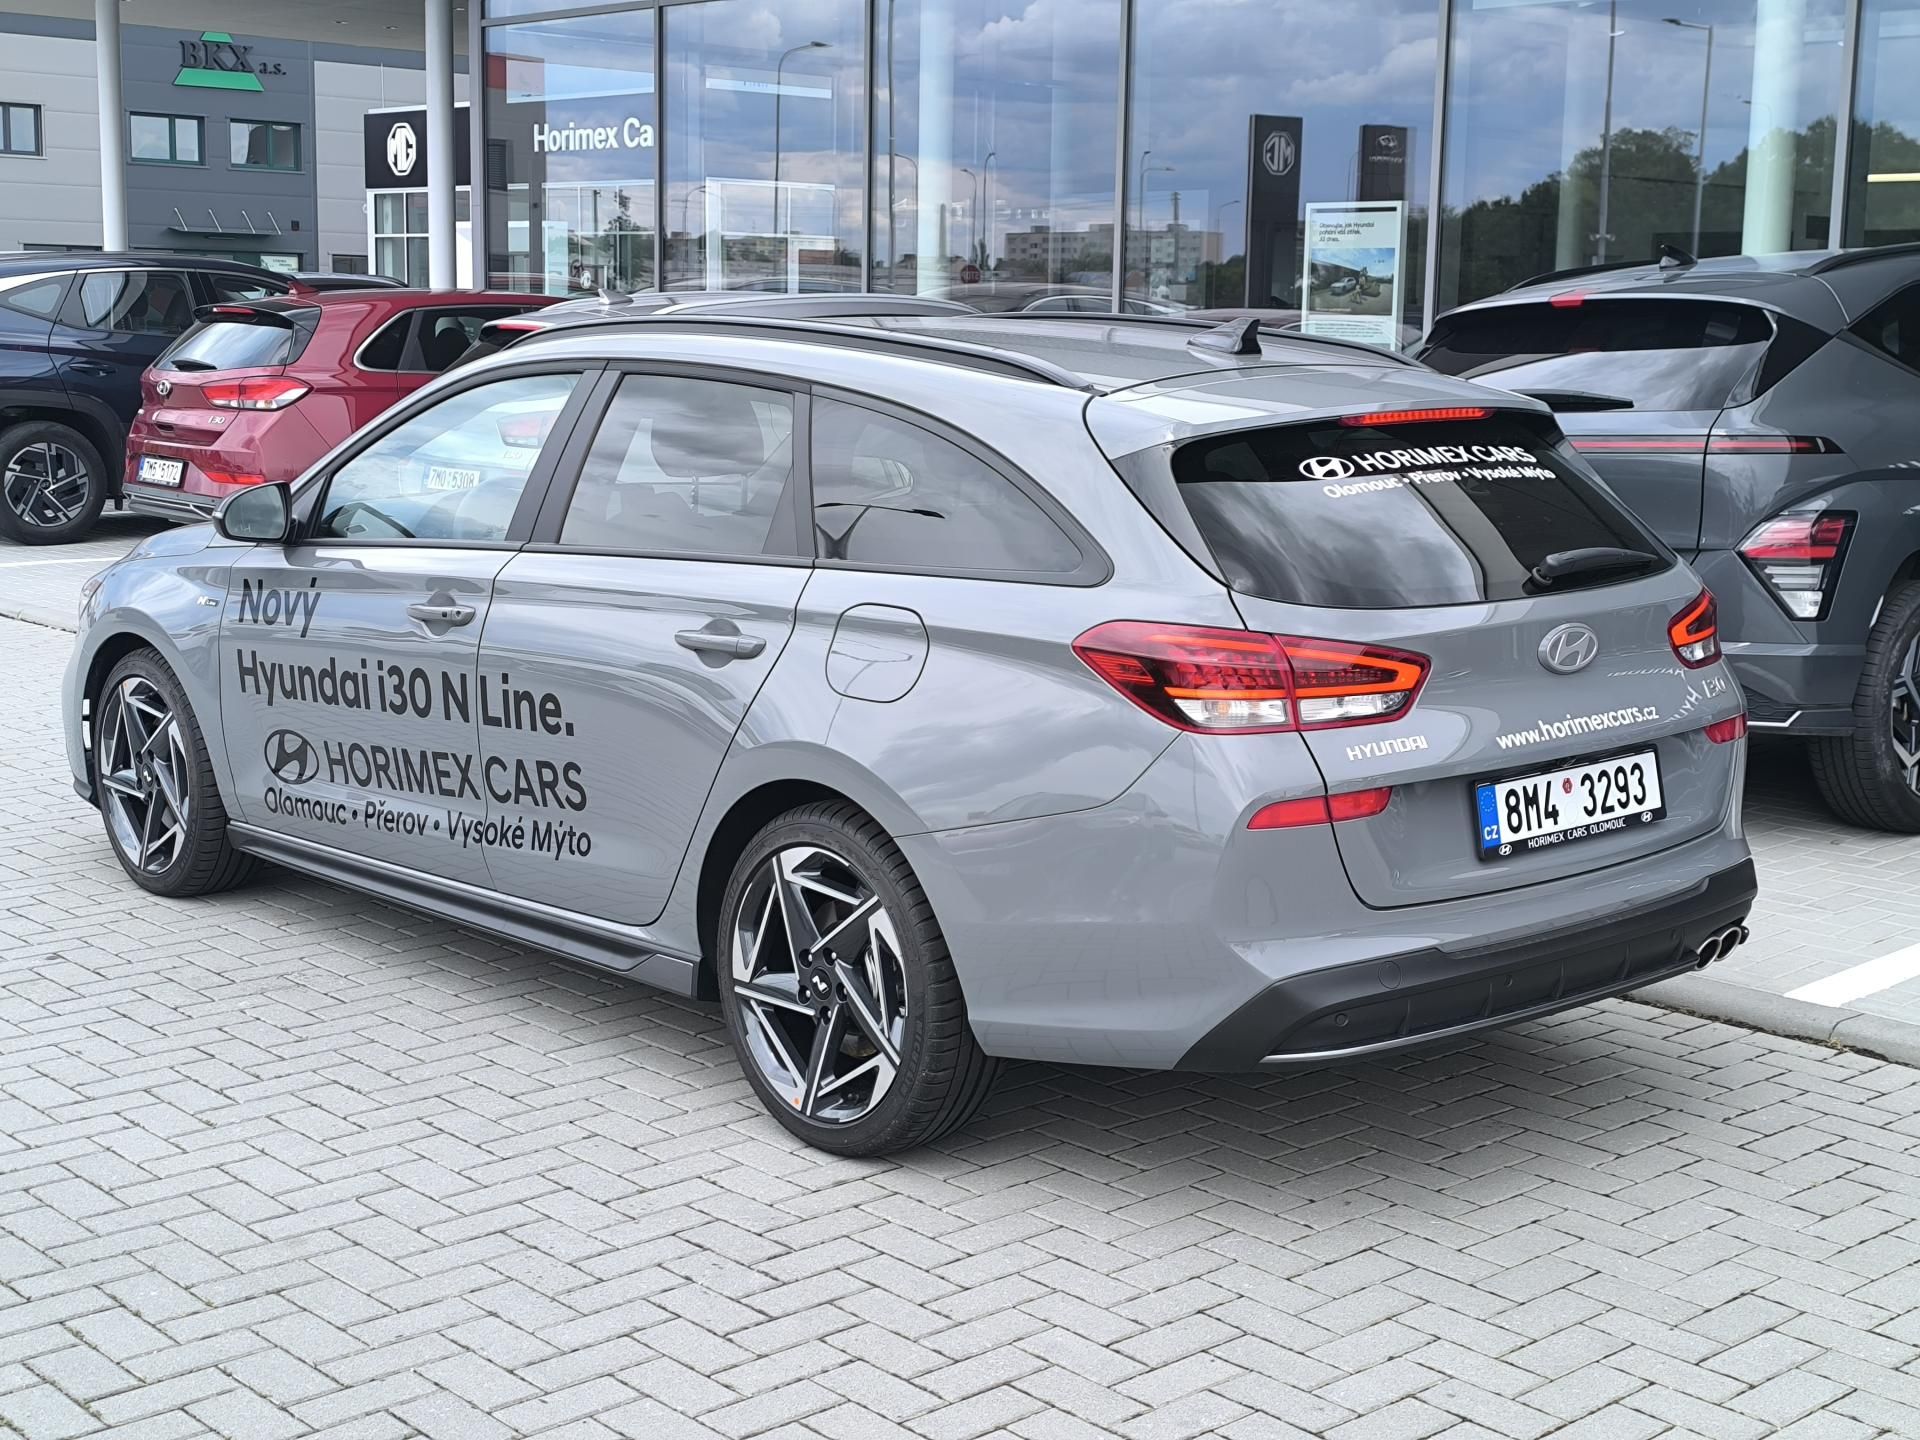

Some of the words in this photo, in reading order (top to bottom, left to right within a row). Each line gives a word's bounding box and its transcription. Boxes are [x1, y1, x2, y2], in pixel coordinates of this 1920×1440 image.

[179, 40, 255, 73] BKX
[259, 61, 287, 75] a.s.
[388, 123, 416, 175] MG
[533, 122, 620, 153] Horimex
[1352, 446, 1474, 472] HORIMEX
[1471, 445, 1538, 464] CARS
[1323, 476, 1404, 499] Olomouc
[1408, 470, 1462, 486] Přerov
[1465, 466, 1523, 481] Vysoké
[1522, 466, 1556, 481] Mýto
[238, 577, 321, 638] Nový
[237, 648, 372, 709] Hyundai
[377, 659, 432, 719] i30
[441, 671, 471, 724] N
[480, 673, 575, 737] Line.
[1496, 704, 1660, 750] www.horimexcars.cz
[1346, 735, 1429, 761] HYUNDAI
[324, 740, 482, 800] HORIMEX
[484, 755, 588, 812] CARS
[1504, 781, 1559, 834] 8M4
[1580, 762, 1647, 818] 3293
[264, 786, 347, 826] Olomouc
[364, 799, 429, 837] Přerov
[447, 810, 525, 850] Vysoké
[531, 819, 592, 861] Mýto
[1484, 825, 1499, 840] CZ
[1528, 832, 1565, 849] HORIMEX
[1567, 826, 1588, 841] CARS
[1590, 817, 1627, 835] OLOMOUC
